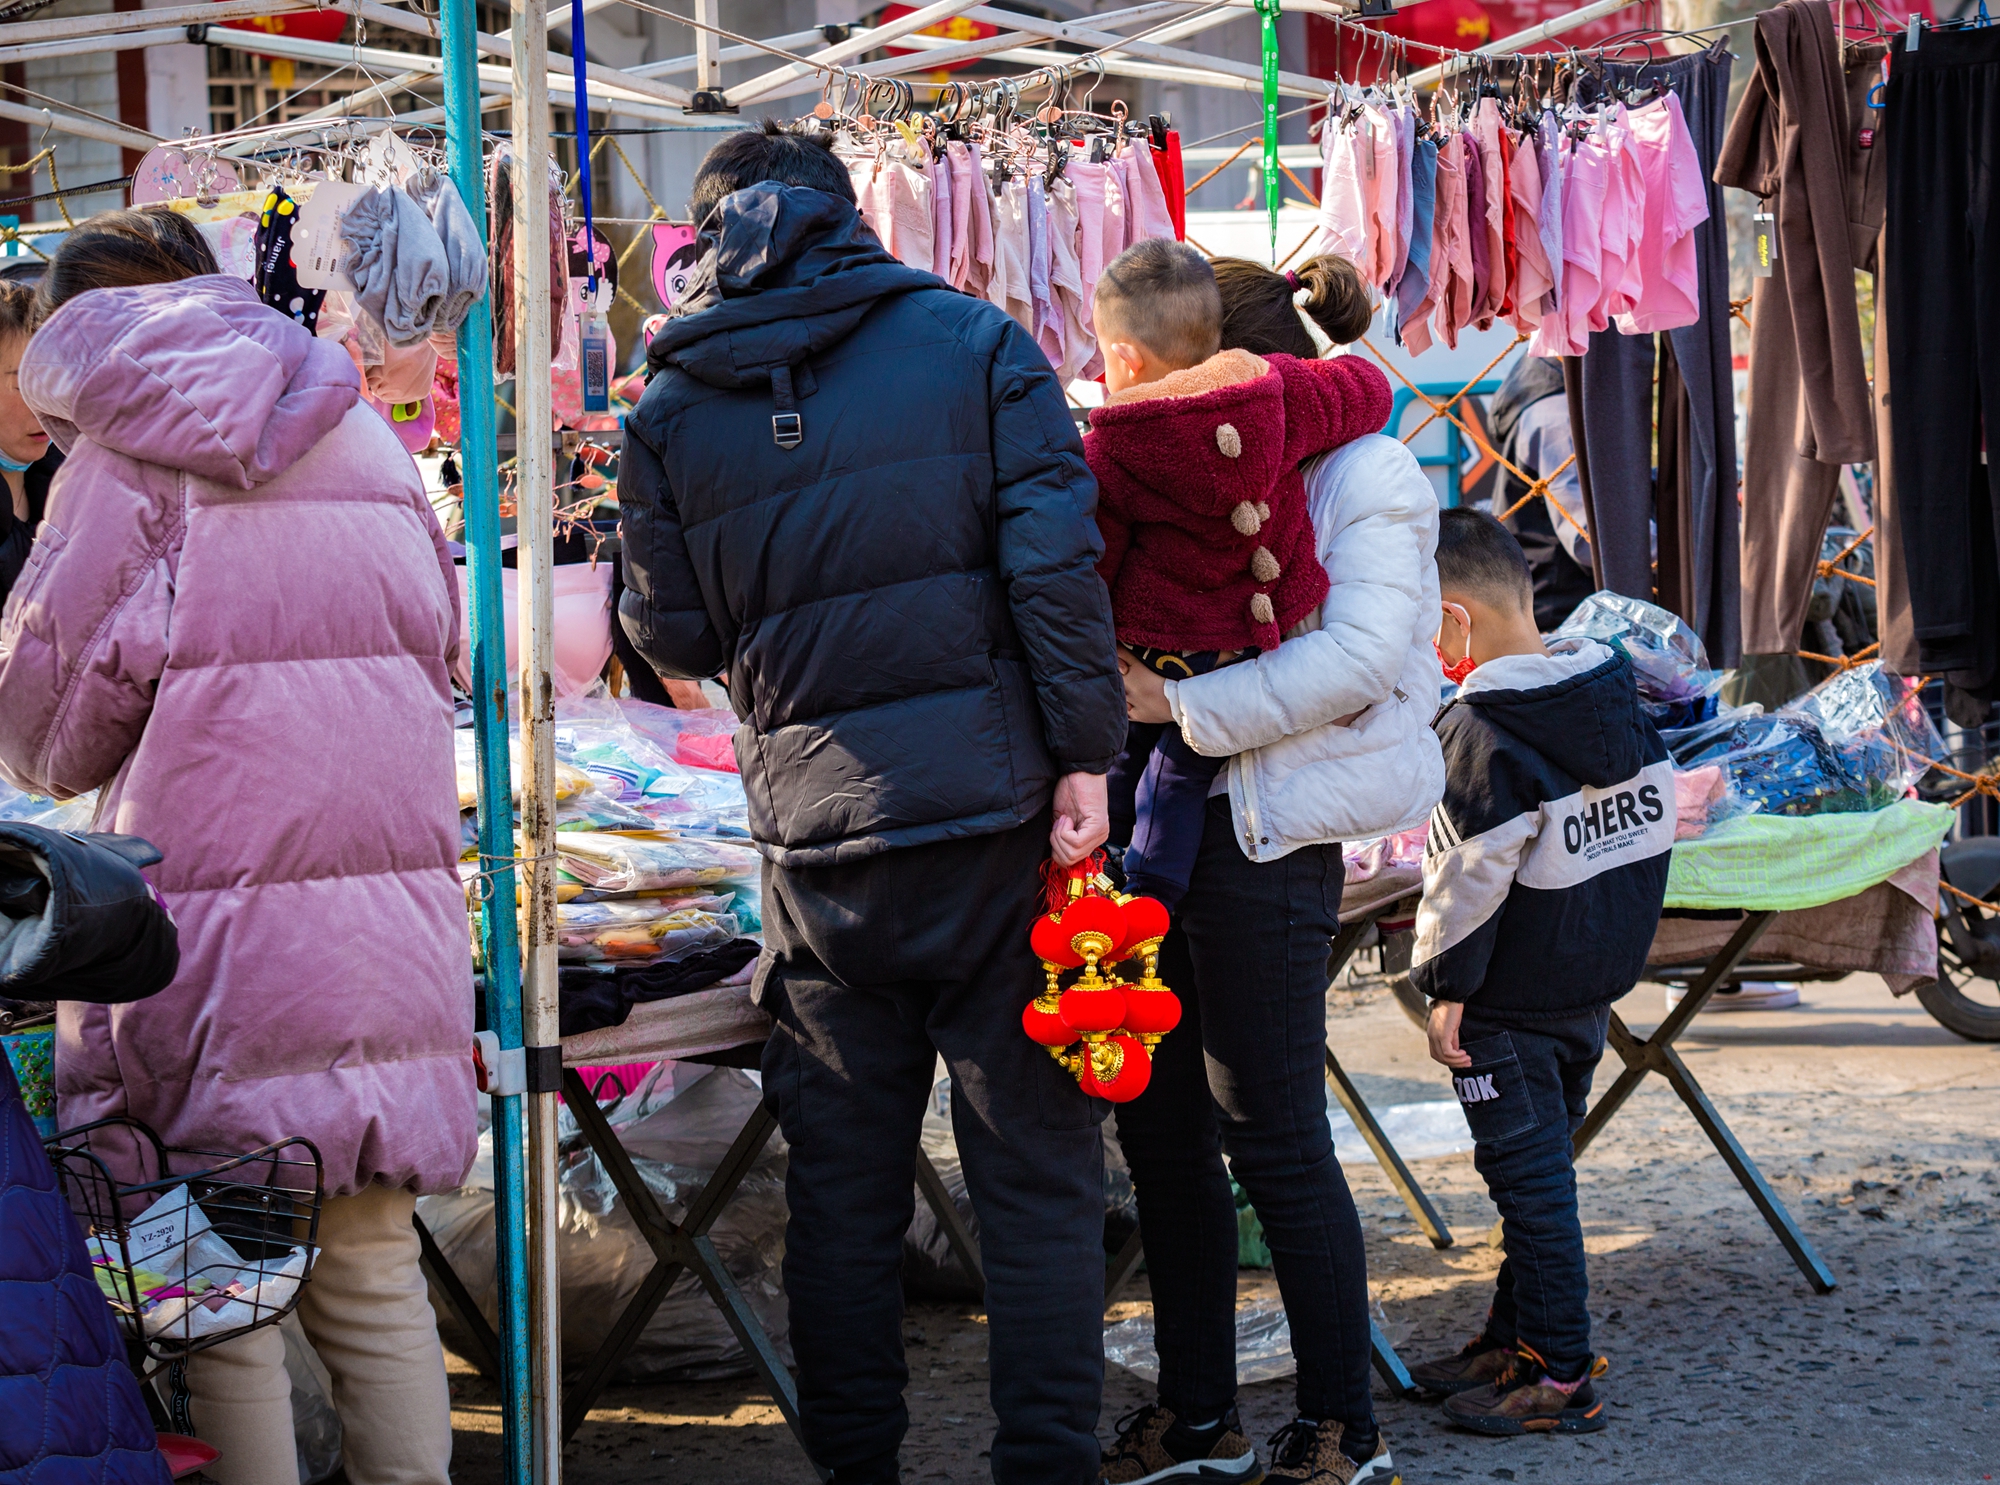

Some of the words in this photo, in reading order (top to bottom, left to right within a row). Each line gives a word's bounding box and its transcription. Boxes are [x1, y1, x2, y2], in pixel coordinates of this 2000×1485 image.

[266, 236, 286, 274] Jiamei
[1602, 837, 1615, 846] MAKE
[1615, 833, 1628, 842] YOU
[1627, 827, 1649, 839] SWEET
[141, 1225, 175, 1243] YZ-2920
[175, 1395, 184, 1413] LOS
